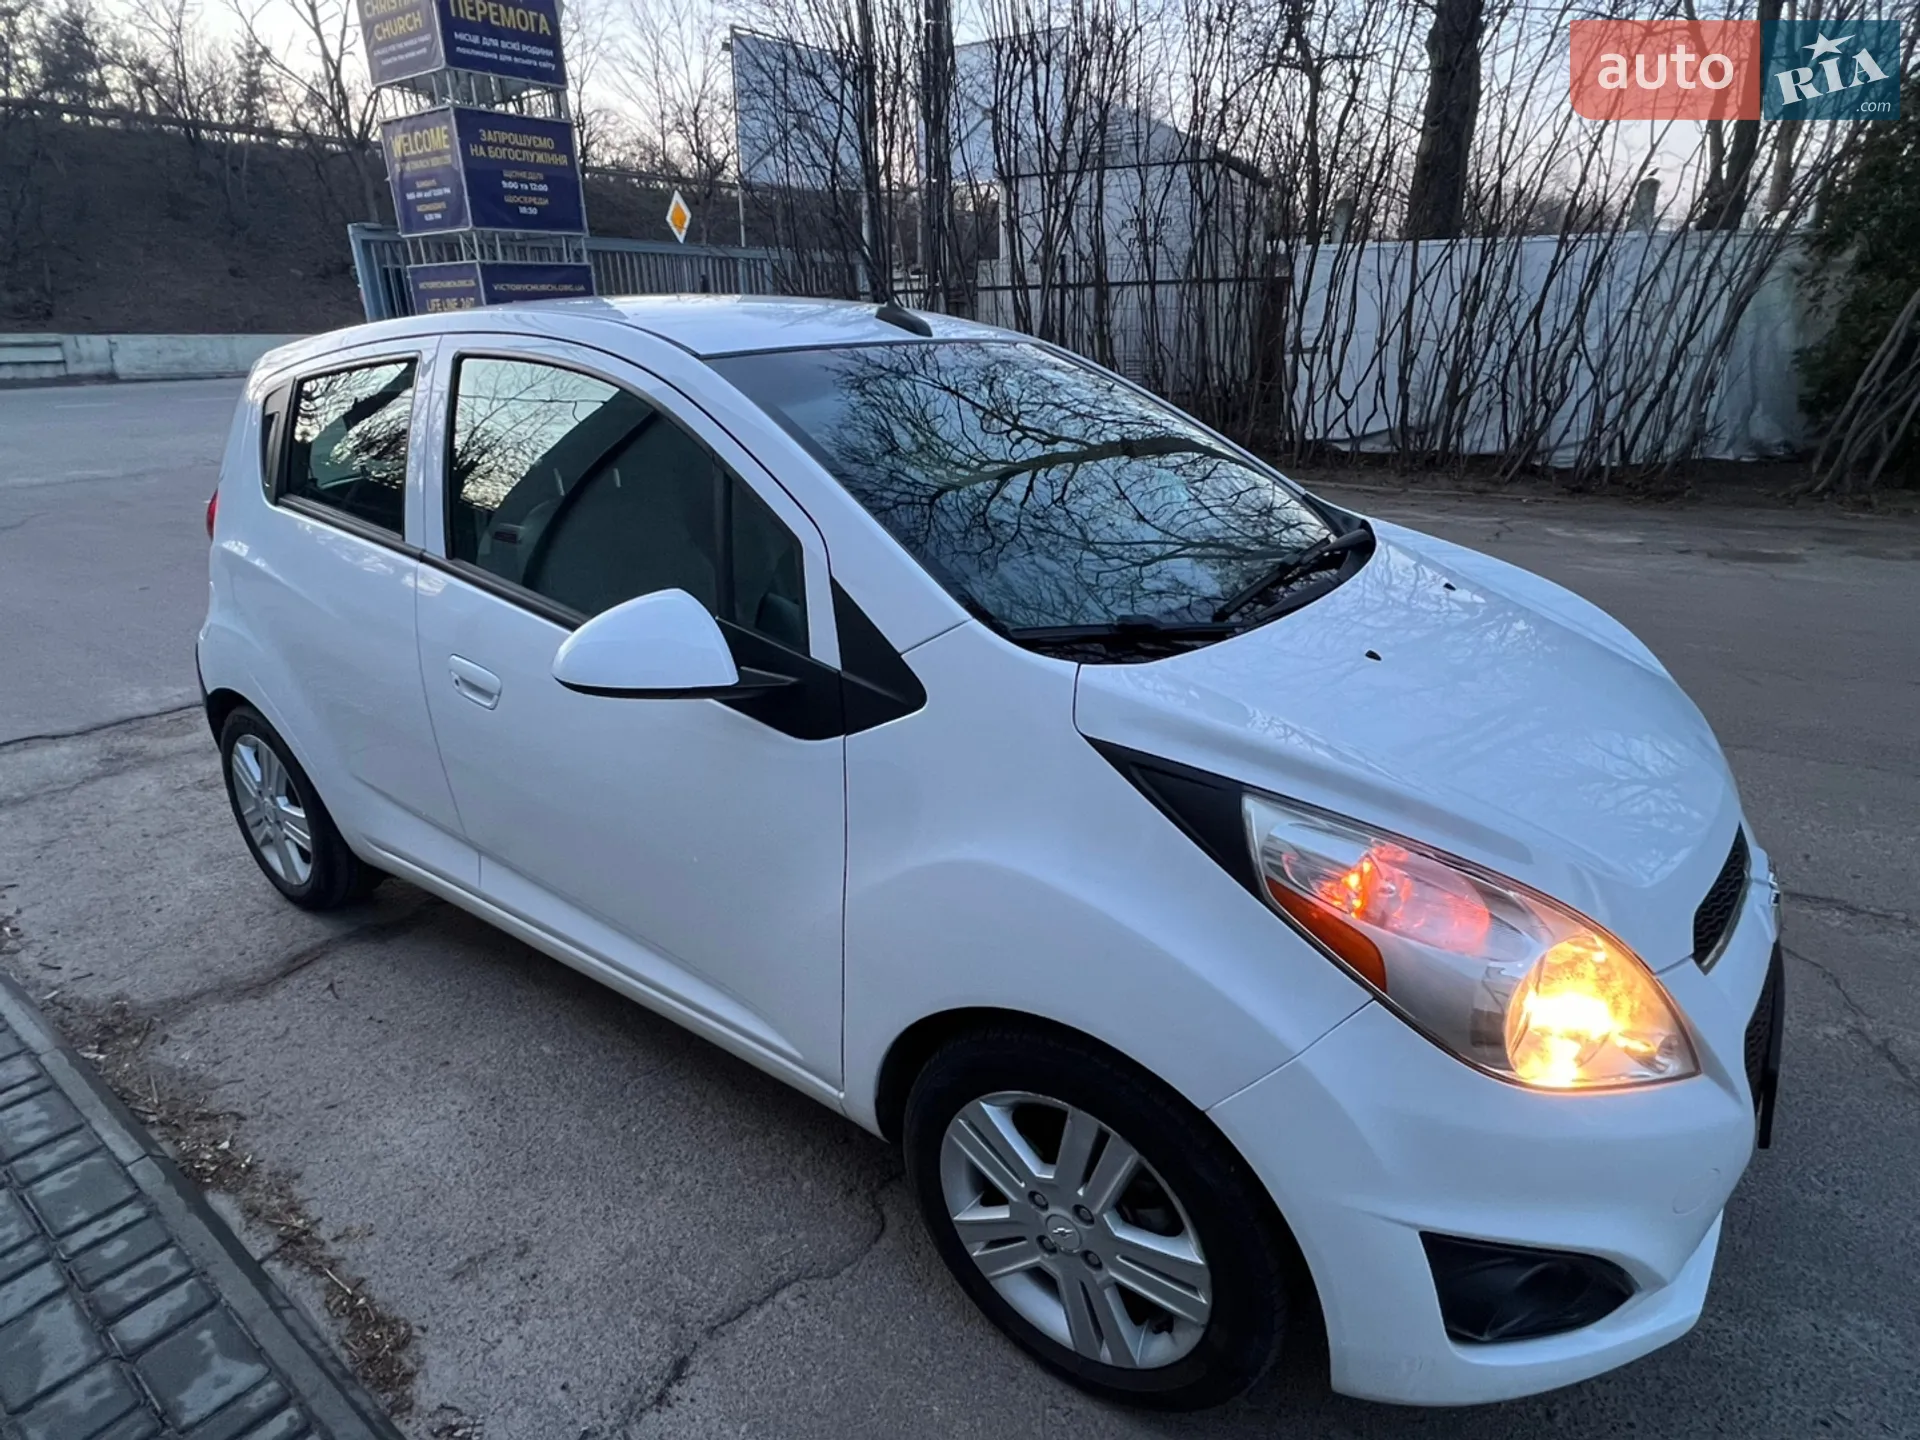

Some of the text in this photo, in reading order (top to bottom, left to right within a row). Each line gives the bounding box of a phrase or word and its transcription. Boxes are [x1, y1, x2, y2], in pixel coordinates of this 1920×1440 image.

[374, 9, 423, 41] CHURCH
[449, 0, 552, 36] ПЕРЕМОГА
[390, 125, 450, 158] WELCOME
[479, 128, 555, 150] ЗАПРОШУЄМО
[469, 143, 568, 166] НА БОГОСЛУЖІННЯ
[530, 182, 549, 192] 12:00
